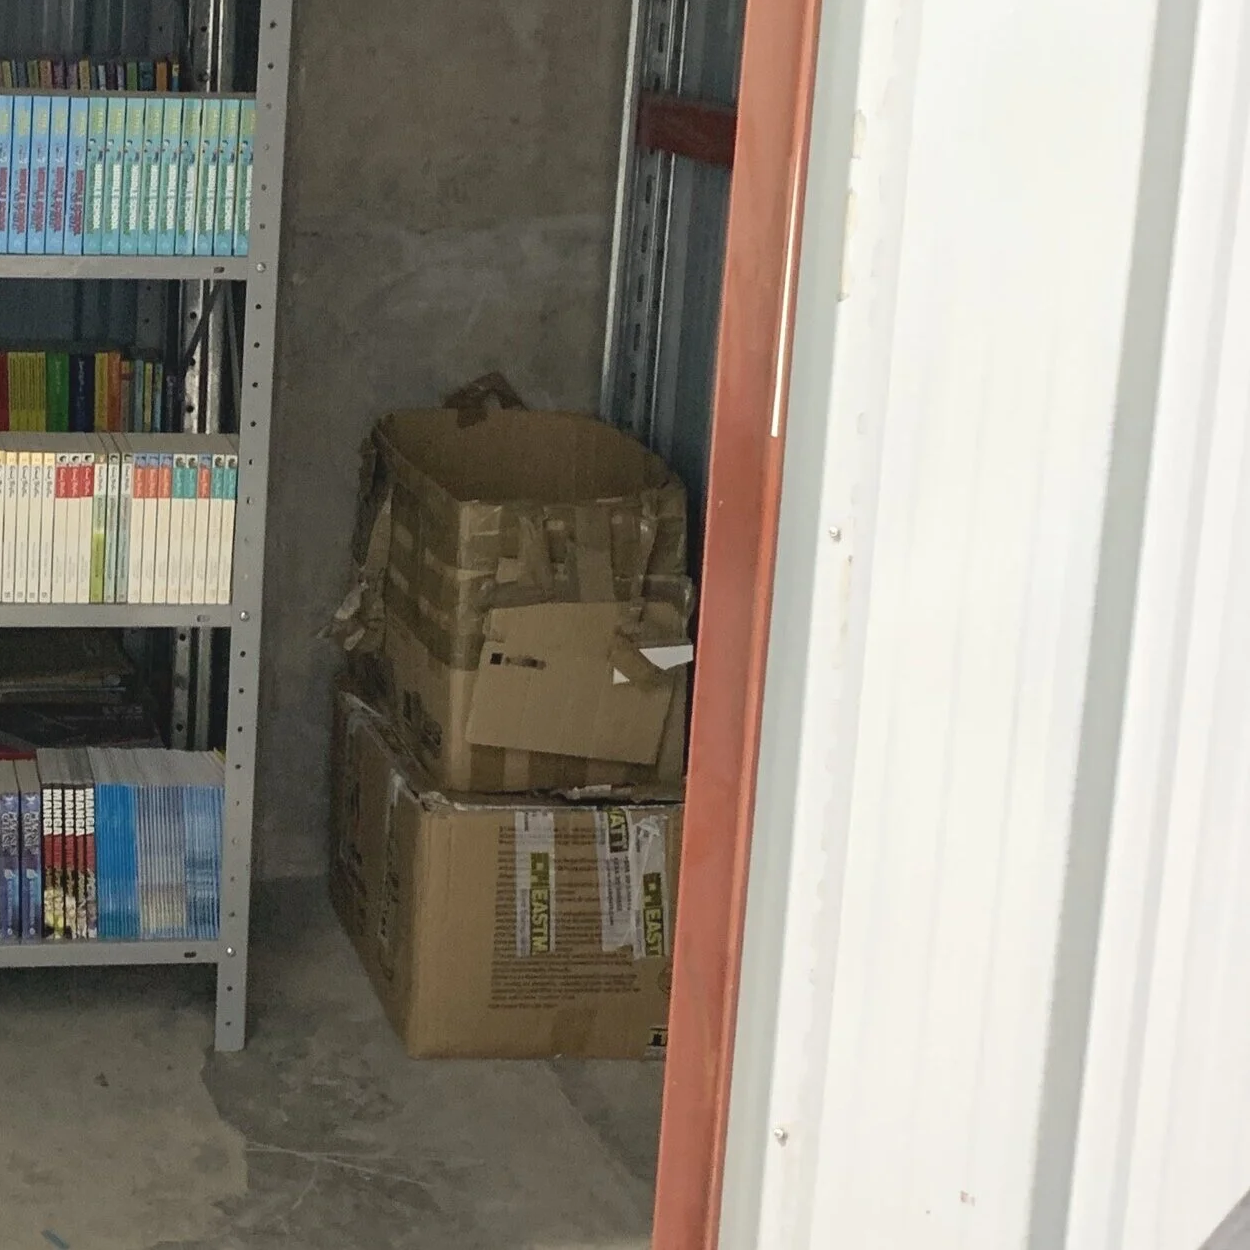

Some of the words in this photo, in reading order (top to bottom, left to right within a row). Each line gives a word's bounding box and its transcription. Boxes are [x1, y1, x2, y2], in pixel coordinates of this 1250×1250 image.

[44, 789, 53, 835] MANGA
[54, 789, 64, 835] MANGA
[66, 789, 75, 835] MANGA
[76, 789, 86, 837] MANGA
[86, 788, 96, 834] MANGA
[532, 889, 549, 954] EASTM
